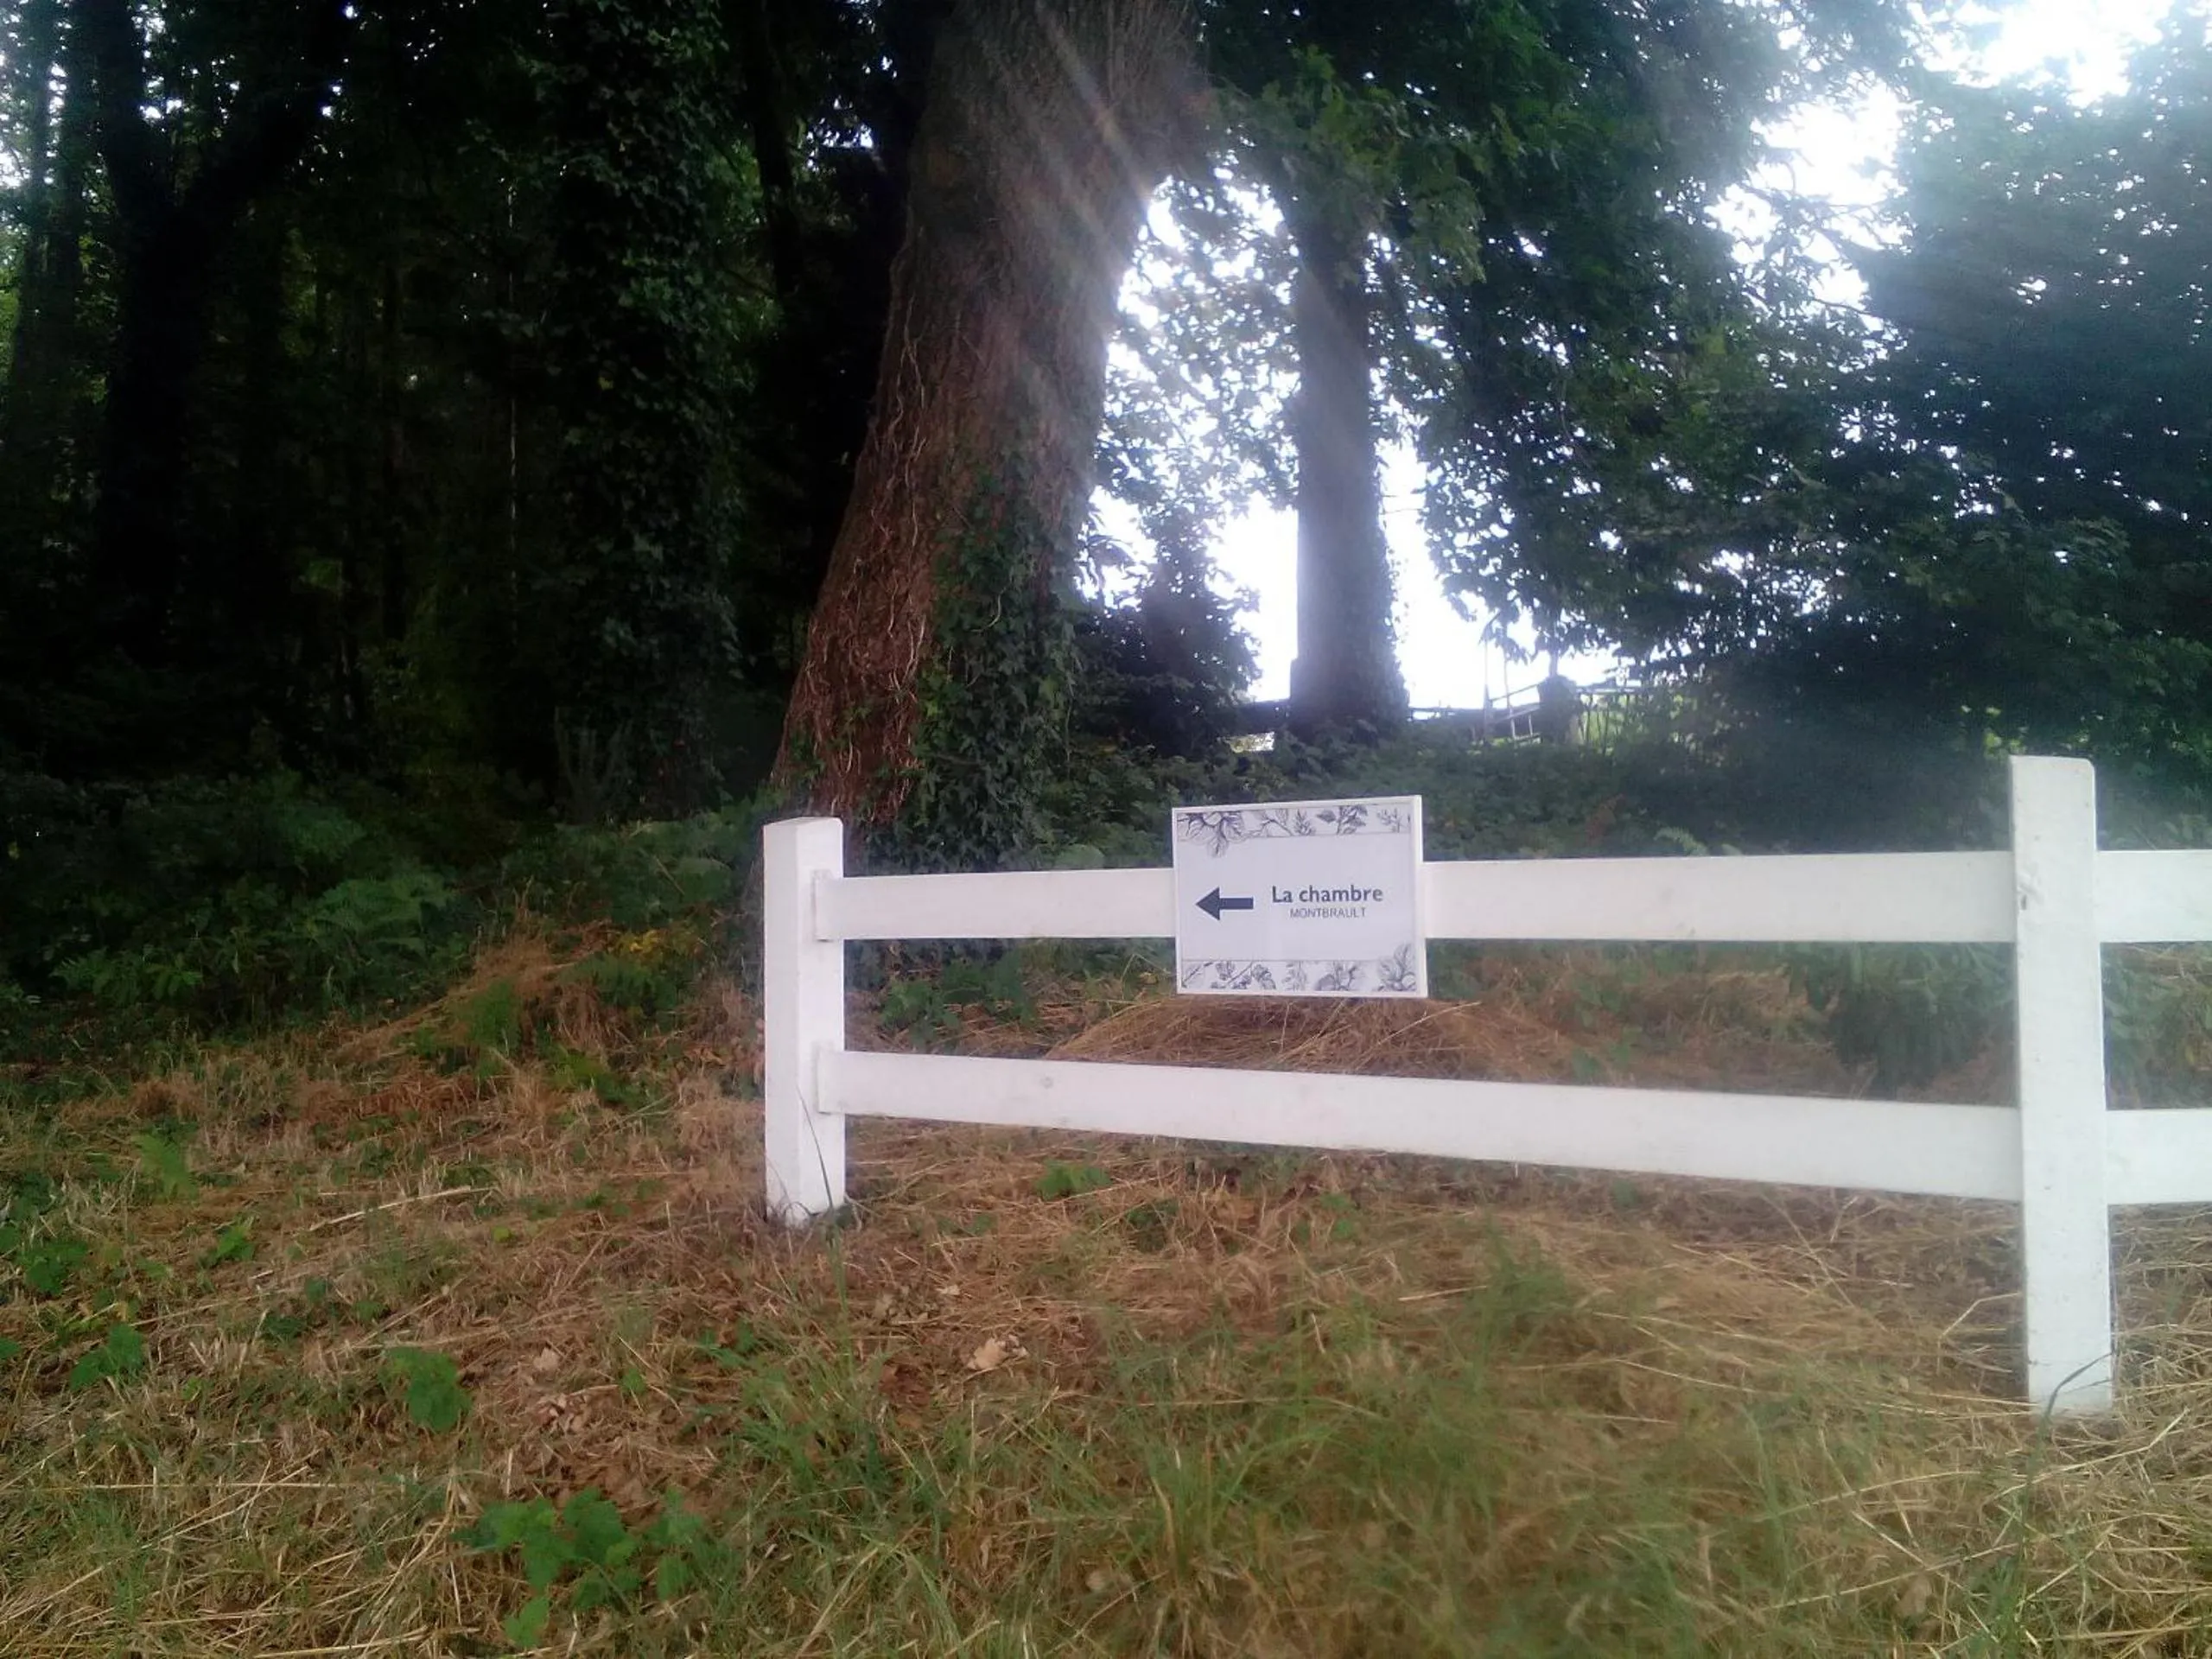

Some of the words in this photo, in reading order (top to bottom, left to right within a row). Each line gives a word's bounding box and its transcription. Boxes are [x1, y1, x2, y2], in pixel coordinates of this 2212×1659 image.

[1272, 885, 1293, 903] La
[1299, 884, 1383, 903] chambre
[1290, 906, 1366, 918] MONTBRAULT
